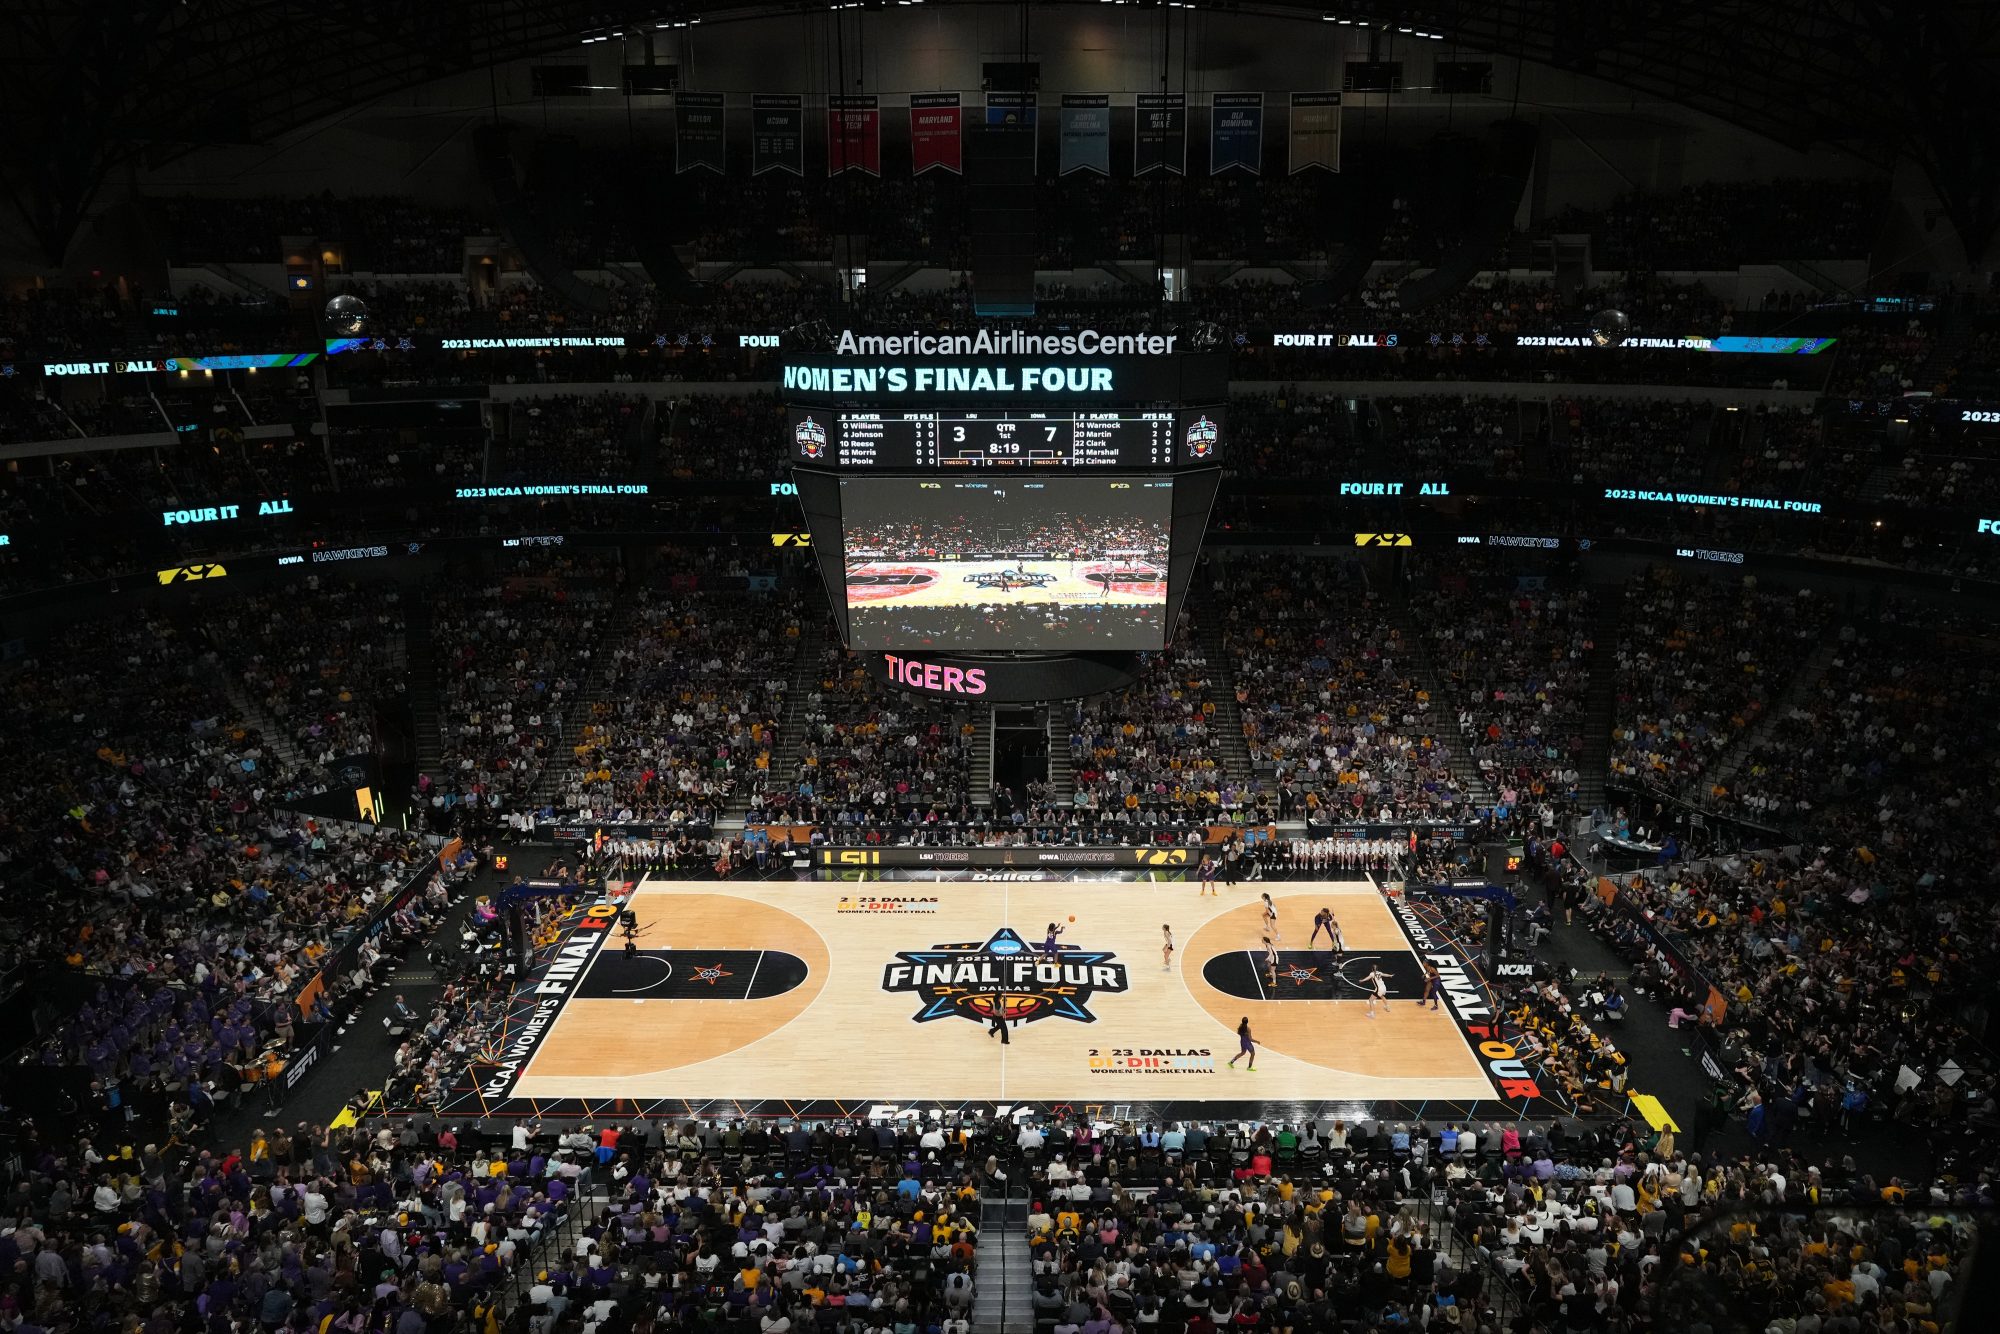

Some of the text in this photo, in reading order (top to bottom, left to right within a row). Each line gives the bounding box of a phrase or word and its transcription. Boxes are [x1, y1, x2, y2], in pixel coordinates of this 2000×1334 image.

[919, 115, 953, 125] MARYLAND
[442, 337, 625, 349] 2023 NCAA WOMEN'S FINAL FOUR
[836, 328, 1177, 356] AmericanAirlinesCenter
[1273, 334, 1316, 346] FOUR
[1317, 334, 1334, 346] IT
[1517, 336, 1712, 349] 2023 NCAA FINAL FOUR
[44, 362, 92, 376] FOUR
[93, 361, 109, 374] IT
[915, 366, 1014, 392] FINAL
[1023, 366, 1115, 392] FOUR
[1961, 411, 2000, 423] 2023
[953, 426, 966, 442] 3
[997, 424, 1016, 432] QTR
[1045, 427, 1057, 442] 7
[990, 443, 1020, 453] 8:19
[456, 484, 648, 498] 2023 NCAA WOMEN'S FINAL FOUR
[1340, 483, 1450, 495] FOUR IT ALL
[1604, 489, 1821, 513] 2023 NCAA WOMEN'S FINAL FOUR
[163, 500, 294, 526] FOUR IT ALL
[502, 539, 519, 548] LSU
[1457, 536, 1560, 549] IOWA HAWKEYES
[278, 546, 387, 566] IOWA HAWKEYES
[1677, 549, 1744, 564] LSU TIGERS
[885, 653, 986, 695] TIGERS
[935, 853, 969, 861] TIGERS
[1059, 853, 1115, 861] HAWKEYES
[972, 873, 1043, 881] Dallas
[889, 963, 1119, 987] FINAL FOUR
[1496, 963, 1533, 976] NCAA
[1425, 954, 1490, 1020] FINAL
[482, 1059, 518, 1097] NCAA
[508, 998, 559, 1059] WOMEN'S
[534, 932, 601, 994] FINAL
[1140, 1049, 1211, 1057] DALLAS
[287, 1045, 318, 1089] ESPN
[1089, 1058, 1159, 1067] DI DII
